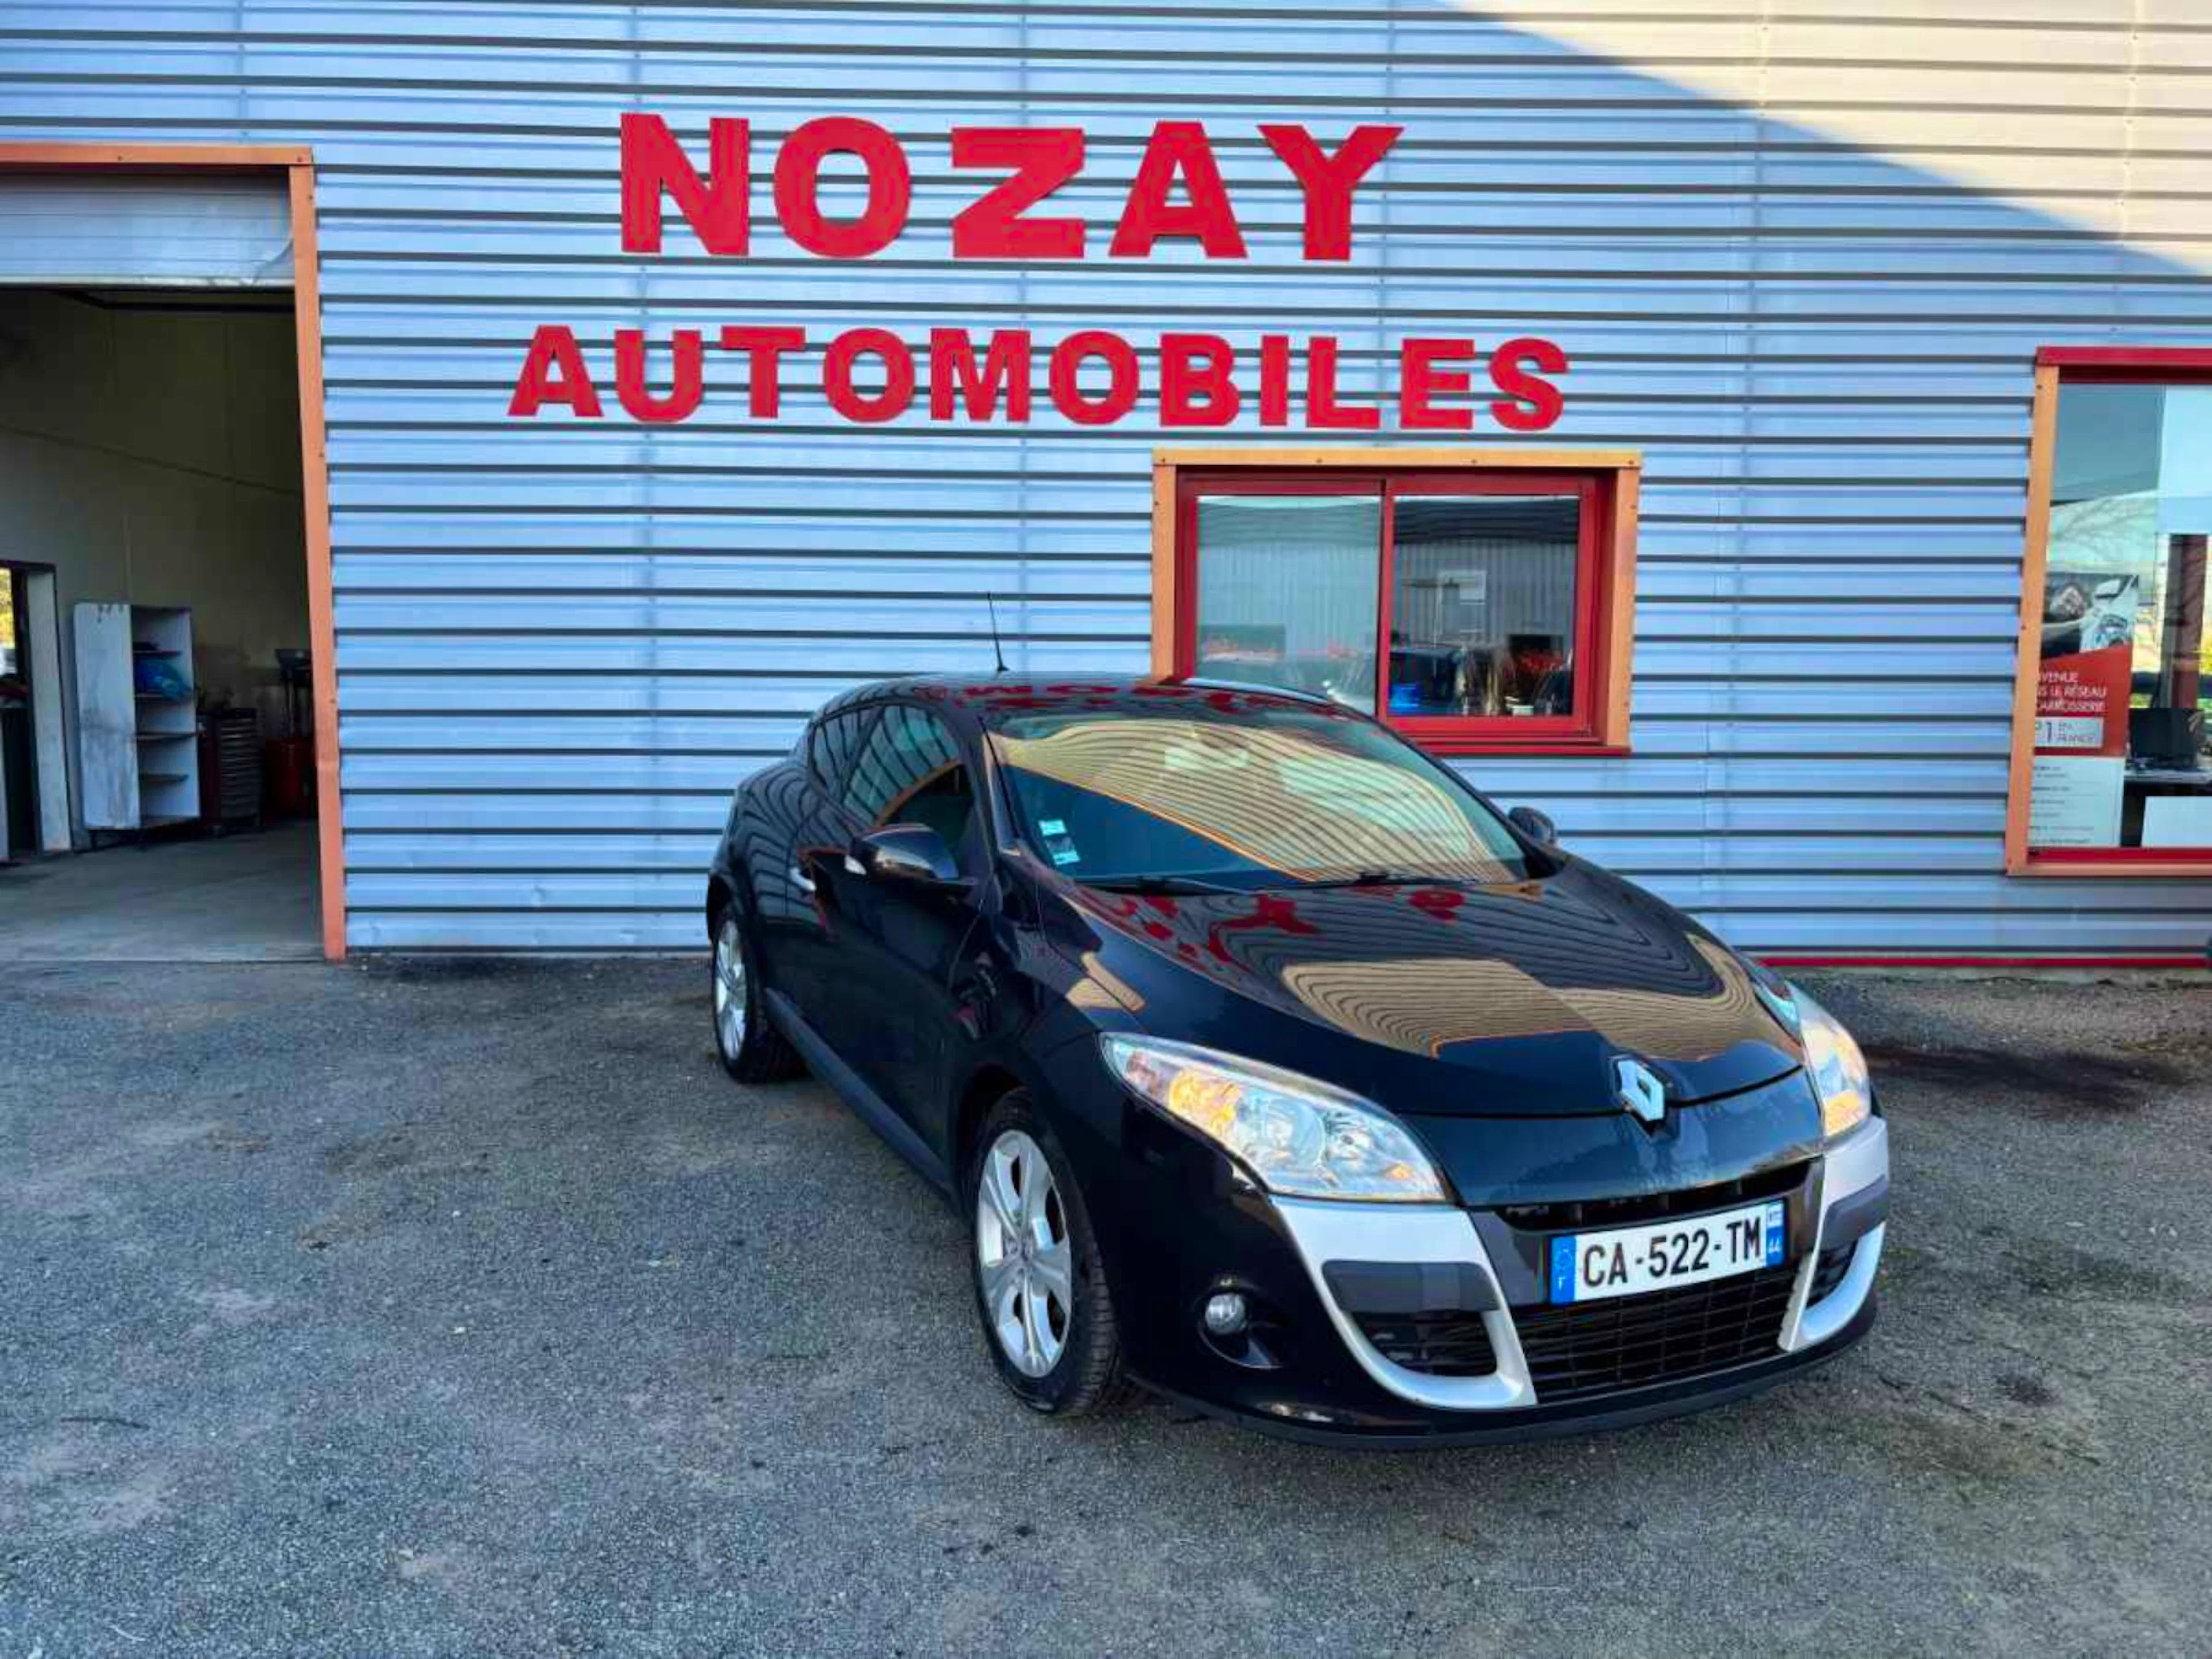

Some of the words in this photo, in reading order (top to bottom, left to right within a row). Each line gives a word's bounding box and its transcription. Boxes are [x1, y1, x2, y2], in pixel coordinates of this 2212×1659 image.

[621, 113, 1404, 261] NOZAY
[508, 325, 1569, 431] AUTOMOBILES
[1582, 1216, 1761, 1287] CA-522-TM
[1768, 1237, 1780, 1253] 44
